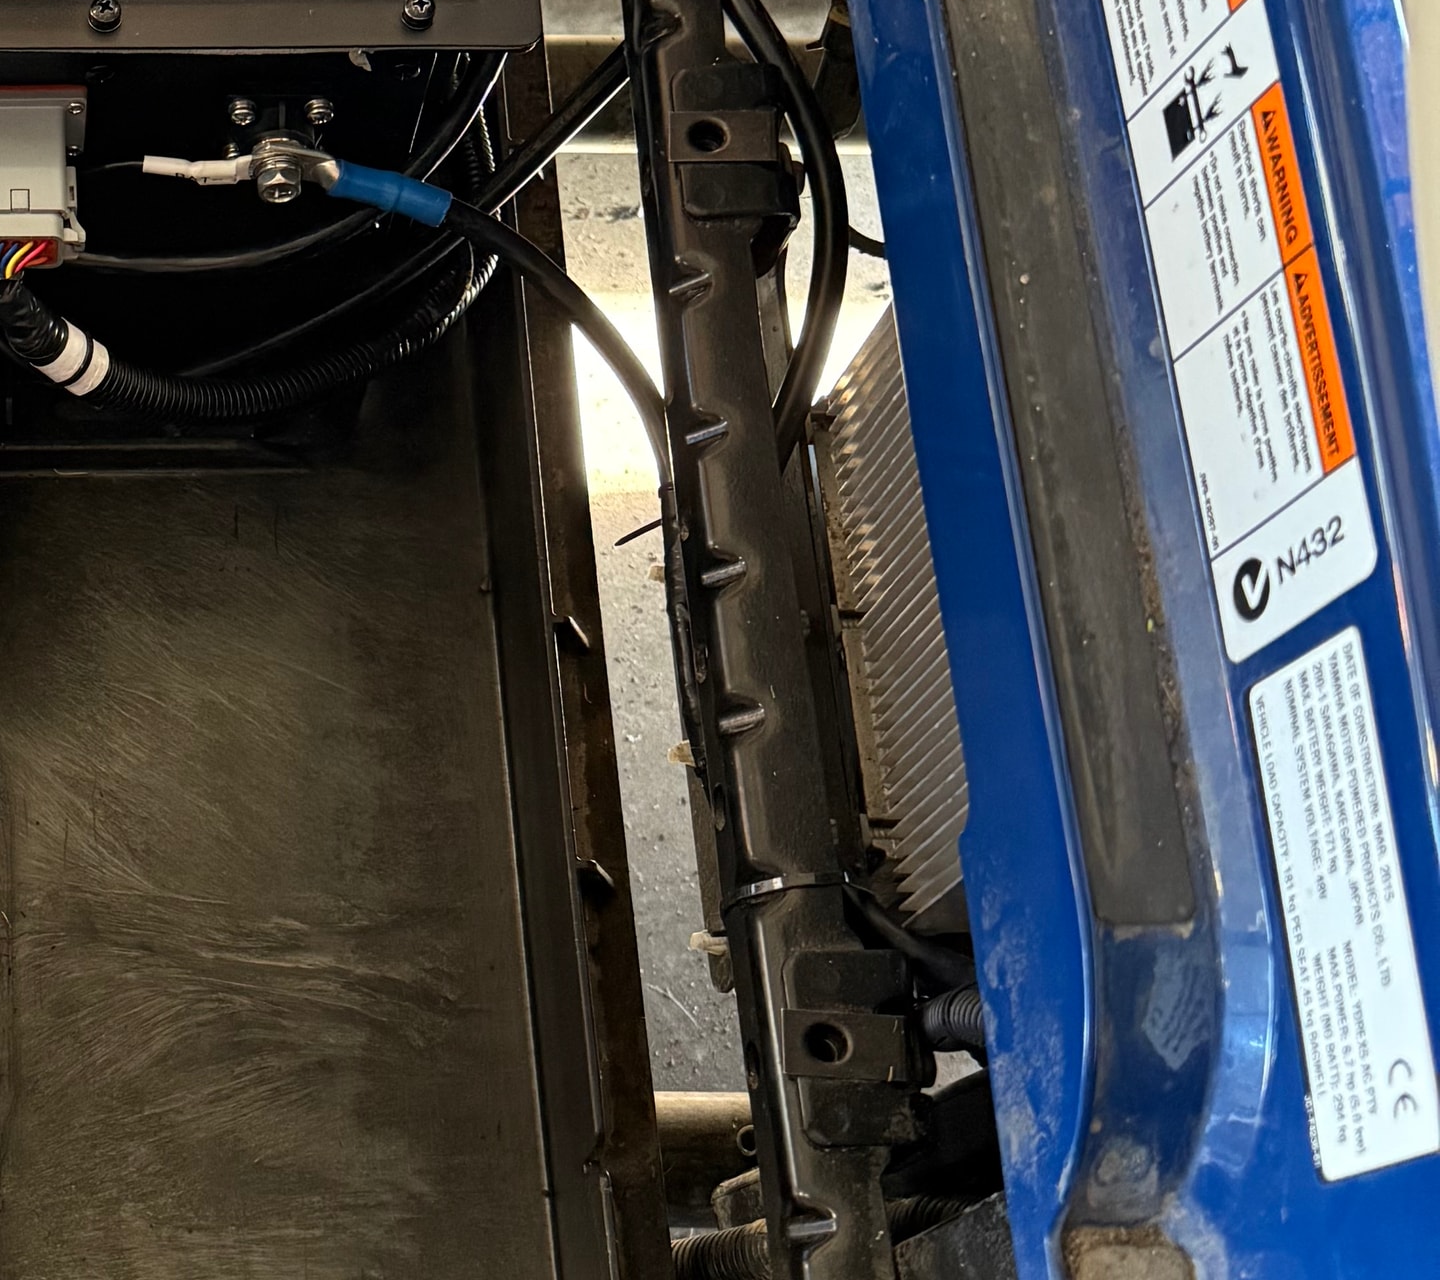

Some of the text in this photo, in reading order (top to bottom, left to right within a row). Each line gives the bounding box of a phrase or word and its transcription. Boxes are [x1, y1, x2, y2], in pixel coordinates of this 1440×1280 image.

[1263, 126, 1299, 248] WARNING
[1296, 288, 1339, 461] ADVERTISSEMENT
[1273, 512, 1346, 585] N432
[1384, 1055, 1418, 1119] CE
